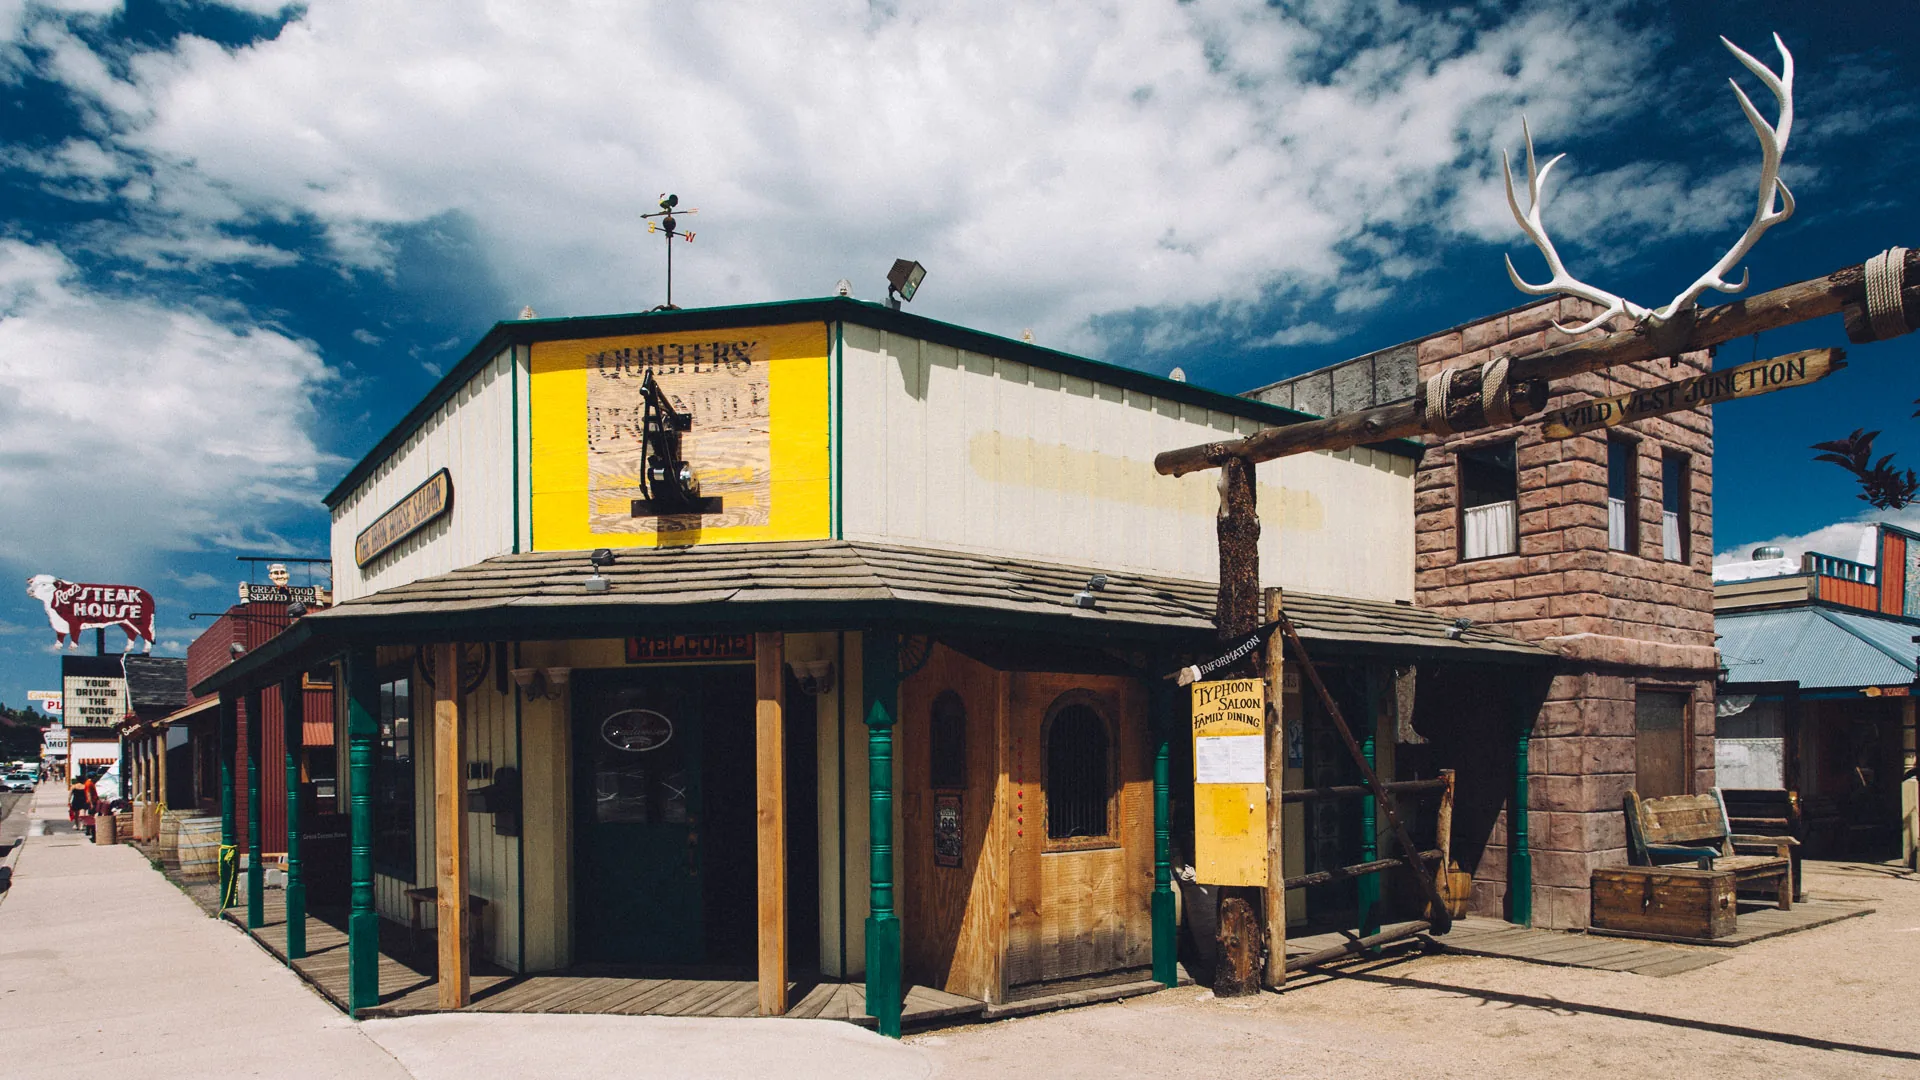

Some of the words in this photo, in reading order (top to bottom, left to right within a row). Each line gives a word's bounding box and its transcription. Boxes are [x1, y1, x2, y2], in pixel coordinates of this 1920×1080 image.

[1560, 402, 1613, 428] WILD
[1616, 387, 1680, 415] WEST
[1685, 357, 1807, 403] JUNCTION
[359, 534, 370, 563] THE
[389, 500, 411, 541] HORSE
[413, 477, 441, 525] SALOON
[76, 587, 142, 603] STEAK
[250, 593, 287, 601] SERVED
[291, 595, 316, 603] HERE
[289, 587, 314, 595] FOOD
[74, 602, 141, 618] HOUSE
[636, 634, 748, 658] WELCOME
[1200, 634, 1261, 675] INFORMATION
[85, 679, 110, 687] YOUR
[1194, 681, 1254, 706] TYPHOON
[1218, 697, 1261, 711] SALOON
[1194, 712, 1225, 729] FAMILY
[1227, 712, 1260, 728] DINING
[942, 817, 956, 829] 66
